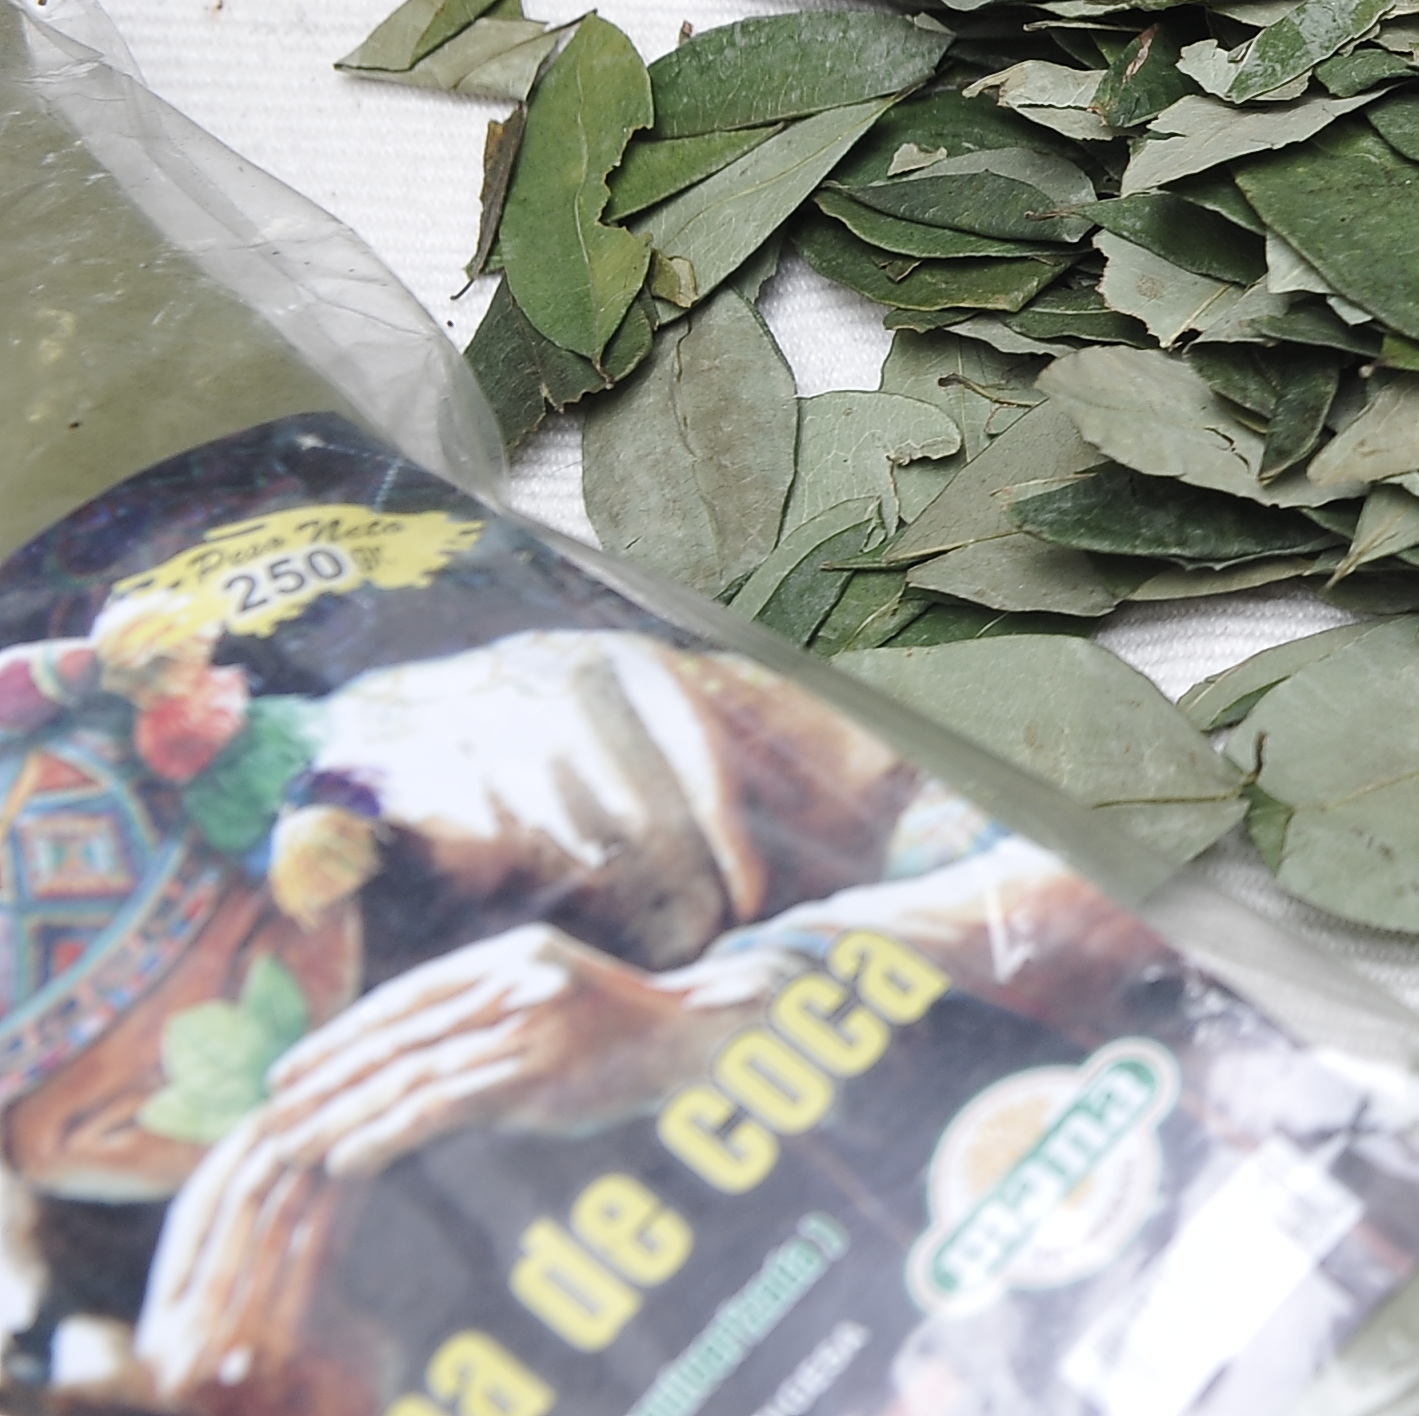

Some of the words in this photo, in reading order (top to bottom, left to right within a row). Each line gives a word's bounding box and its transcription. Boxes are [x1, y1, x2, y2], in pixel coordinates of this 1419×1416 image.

[225, 548, 344, 613] 250
[509, 1172, 694, 1353] de
[656, 927, 953, 1195] coca
